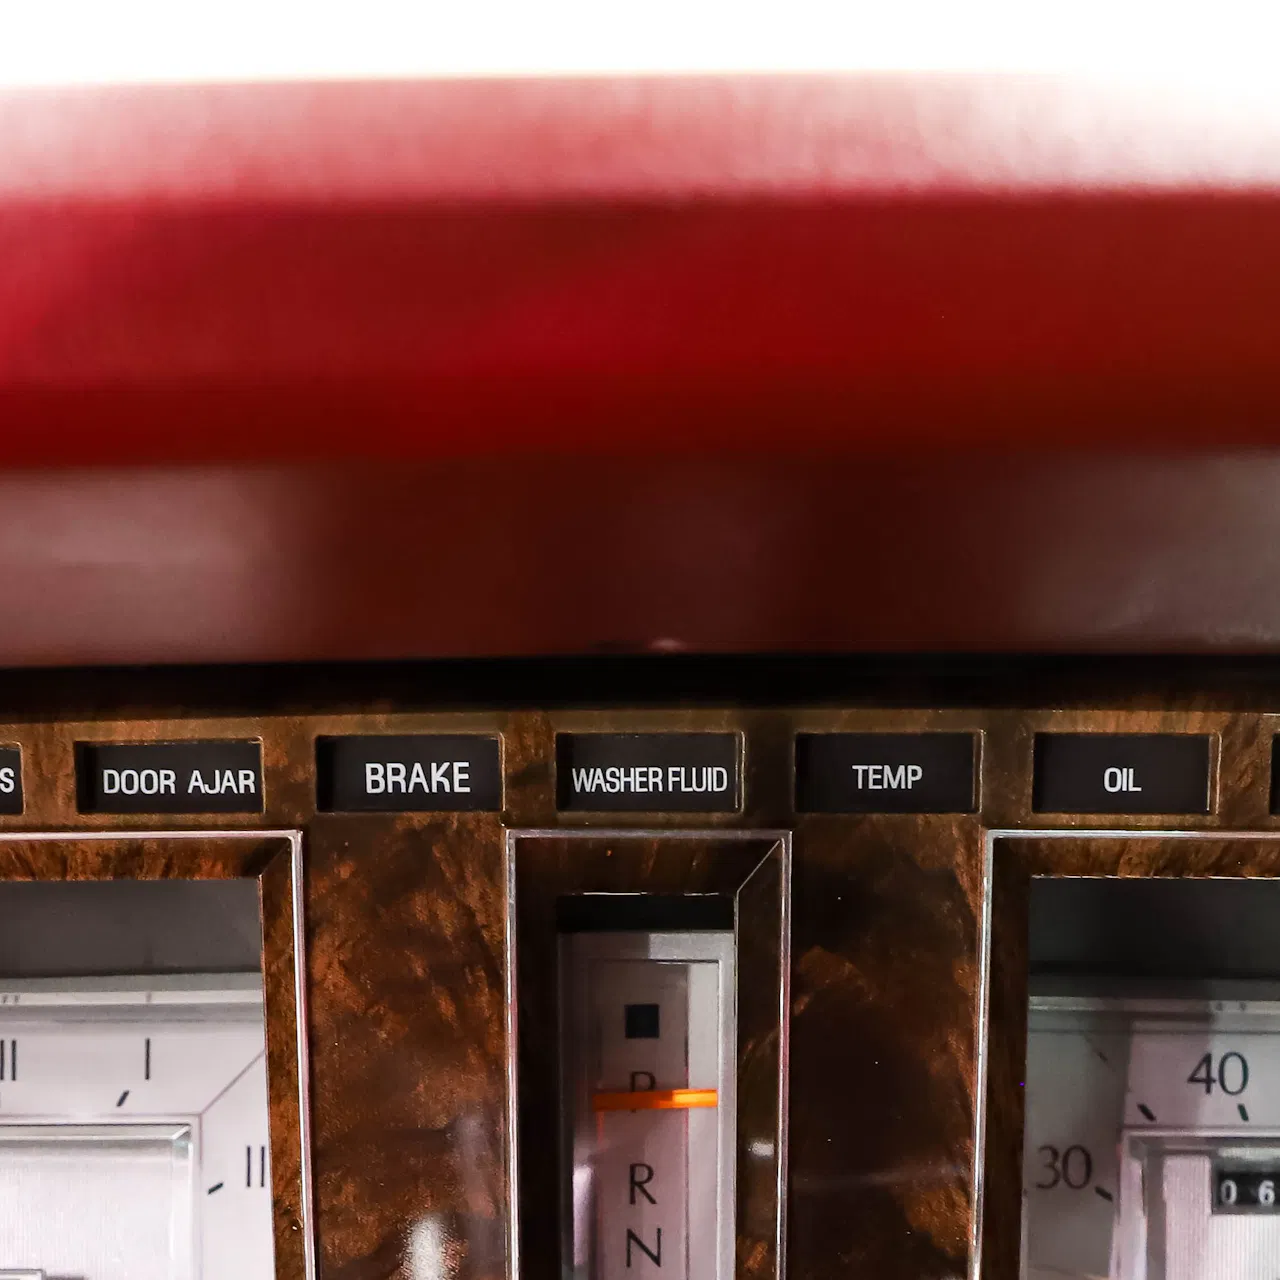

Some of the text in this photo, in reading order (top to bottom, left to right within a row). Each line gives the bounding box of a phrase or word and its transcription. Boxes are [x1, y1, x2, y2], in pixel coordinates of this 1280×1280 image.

[101, 768, 257, 795] DOOR AJAR
[365, 761, 470, 794] BRAKE
[571, 766, 728, 794] WASHER FLUID
[852, 764, 923, 791] TEMP
[1103, 767, 1142, 794] OIL
[1187, 1051, 1250, 1097] 40
[245, 1145, 266, 1188] II
[628, 1163, 656, 1206] R
[1035, 1144, 1093, 1191] 30
[625, 1227, 663, 1269] N
